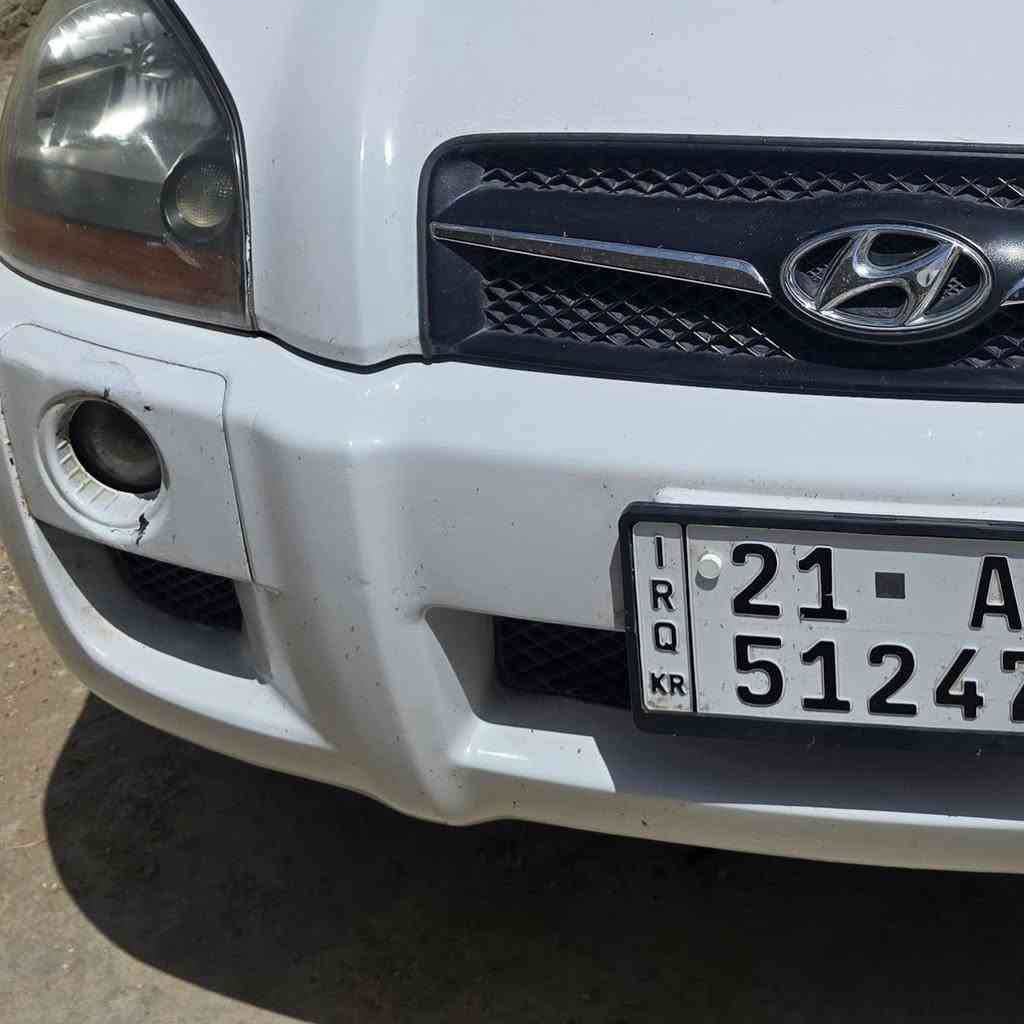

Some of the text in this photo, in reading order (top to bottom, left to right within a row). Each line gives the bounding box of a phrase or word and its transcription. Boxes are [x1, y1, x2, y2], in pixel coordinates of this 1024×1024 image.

[650, 536, 678, 655] IRQ
[731, 543, 1023, 631] 21 A
[650, 672, 686, 697] KR
